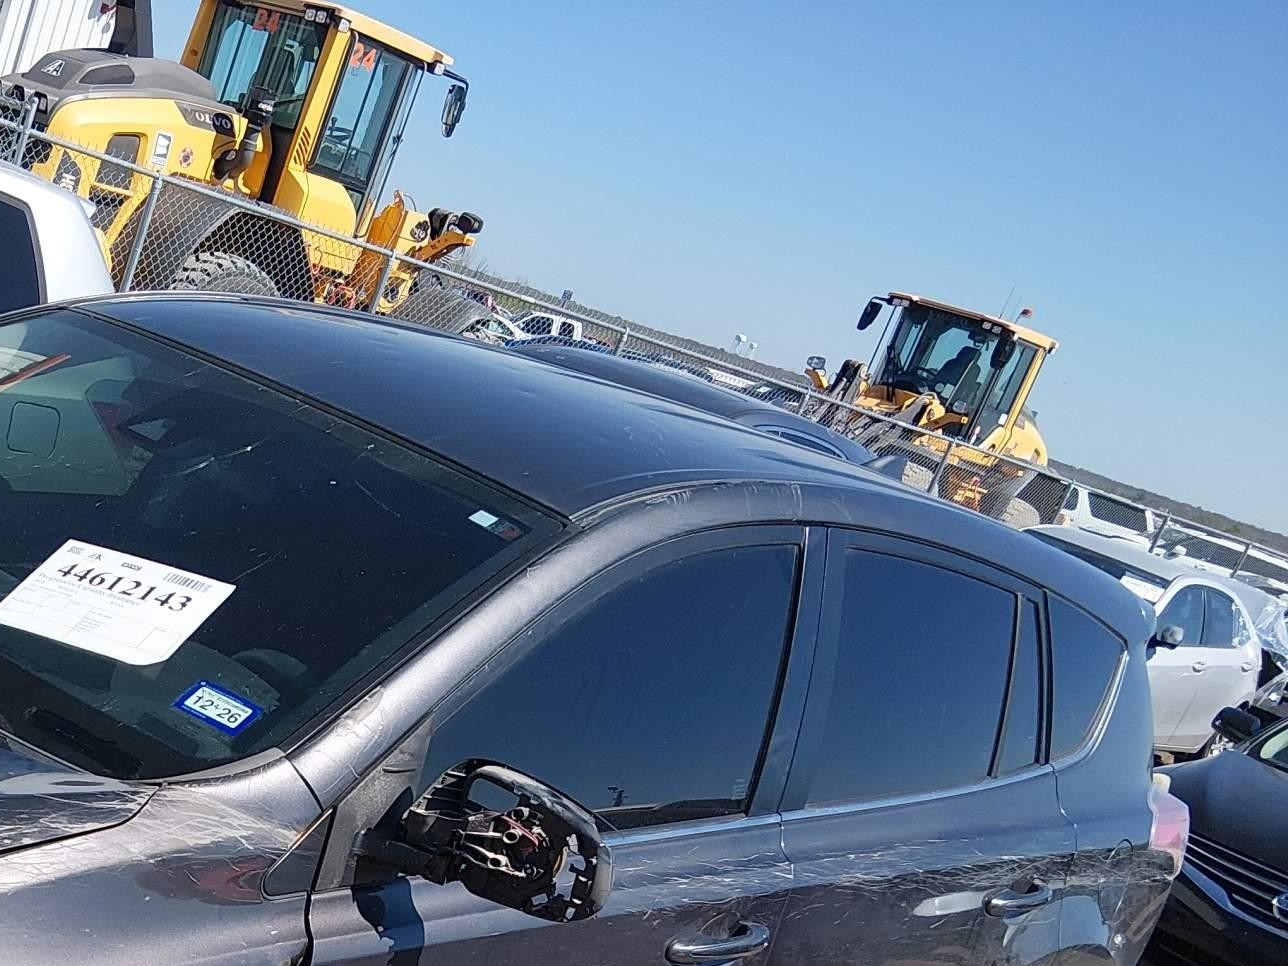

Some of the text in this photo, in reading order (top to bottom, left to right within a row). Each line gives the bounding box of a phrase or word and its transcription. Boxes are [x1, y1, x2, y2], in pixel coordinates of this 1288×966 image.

[253, 8, 280, 33] 24
[349, 42, 377, 72] 24
[57, 563, 192, 611] 44612143
